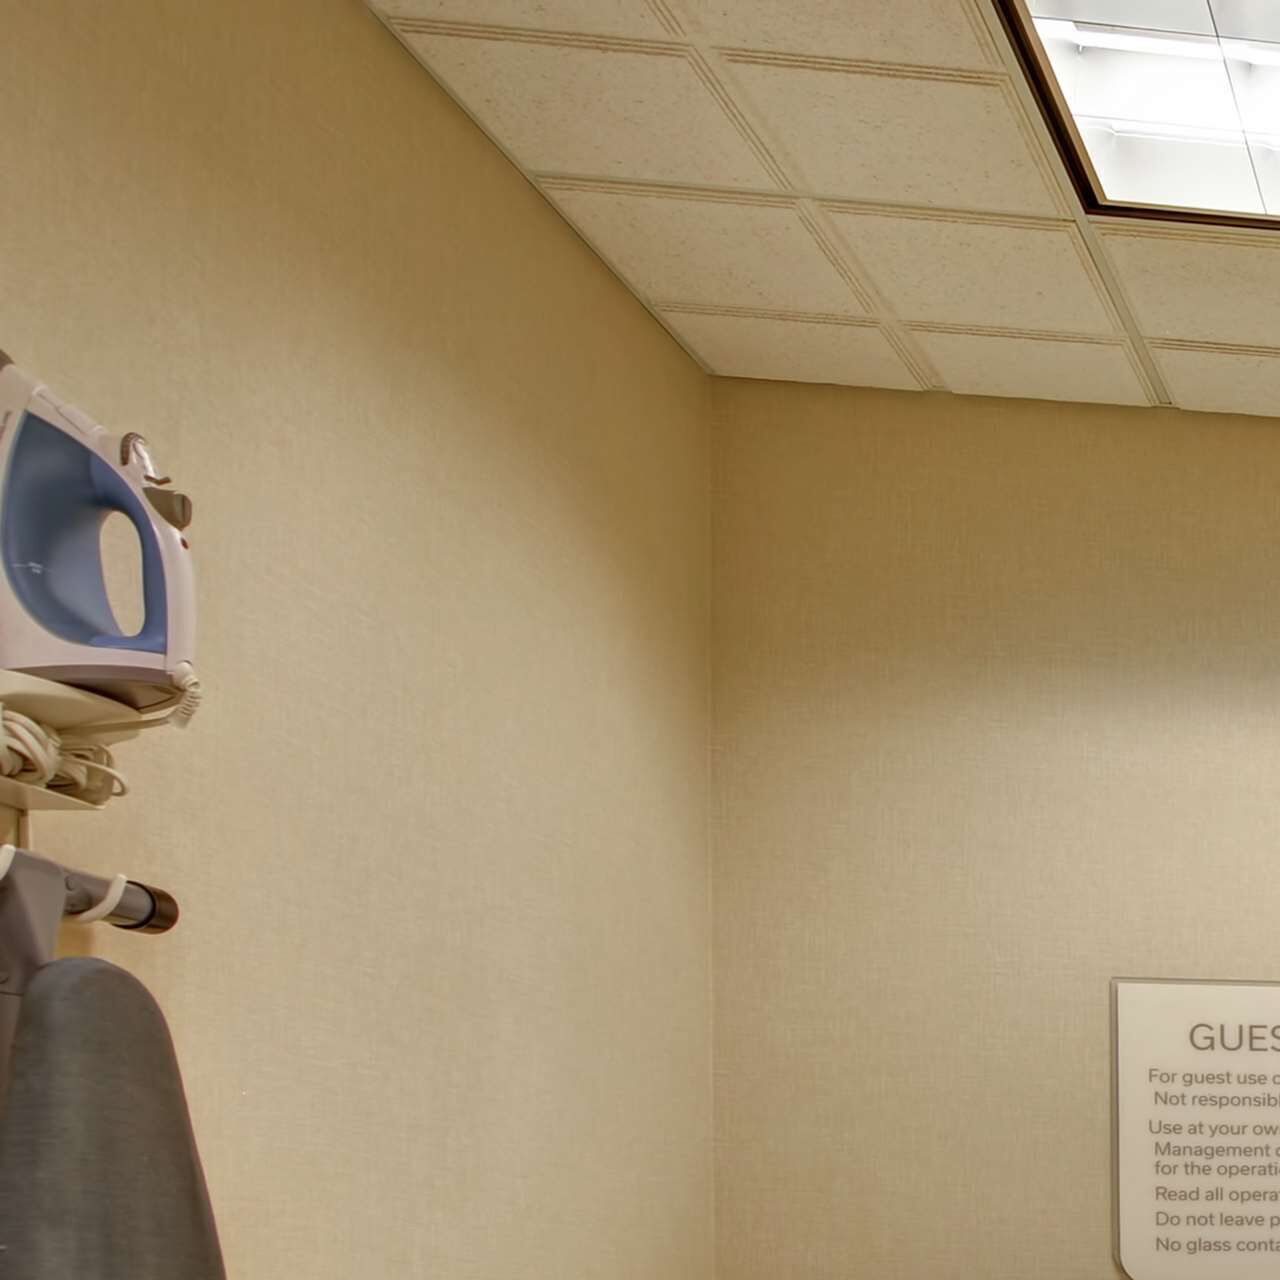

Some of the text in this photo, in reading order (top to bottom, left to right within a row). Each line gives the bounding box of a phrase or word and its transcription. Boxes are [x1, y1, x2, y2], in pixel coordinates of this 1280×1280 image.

[1148, 1067, 1178, 1084] For
[1181, 1071, 1233, 1088] guest
[1236, 1073, 1268, 1086] use
[1154, 1090, 1187, 1107] Not
[1148, 1119, 1184, 1135] Use
[1187, 1121, 1205, 1136] at
[1208, 1123, 1249, 1139] your
[1154, 1140, 1271, 1161] Management
[1154, 1159, 1179, 1176] for
[1183, 1160, 1213, 1176] the
[1155, 1185, 1200, 1202] Read
[1204, 1186, 1224, 1202] all
[1155, 1210, 1182, 1227] Do
[1185, 1212, 1216, 1227] not
[1219, 1212, 1265, 1227] leave
[1155, 1236, 1182, 1252] No
[1185, 1237, 1233, 1255] glass
